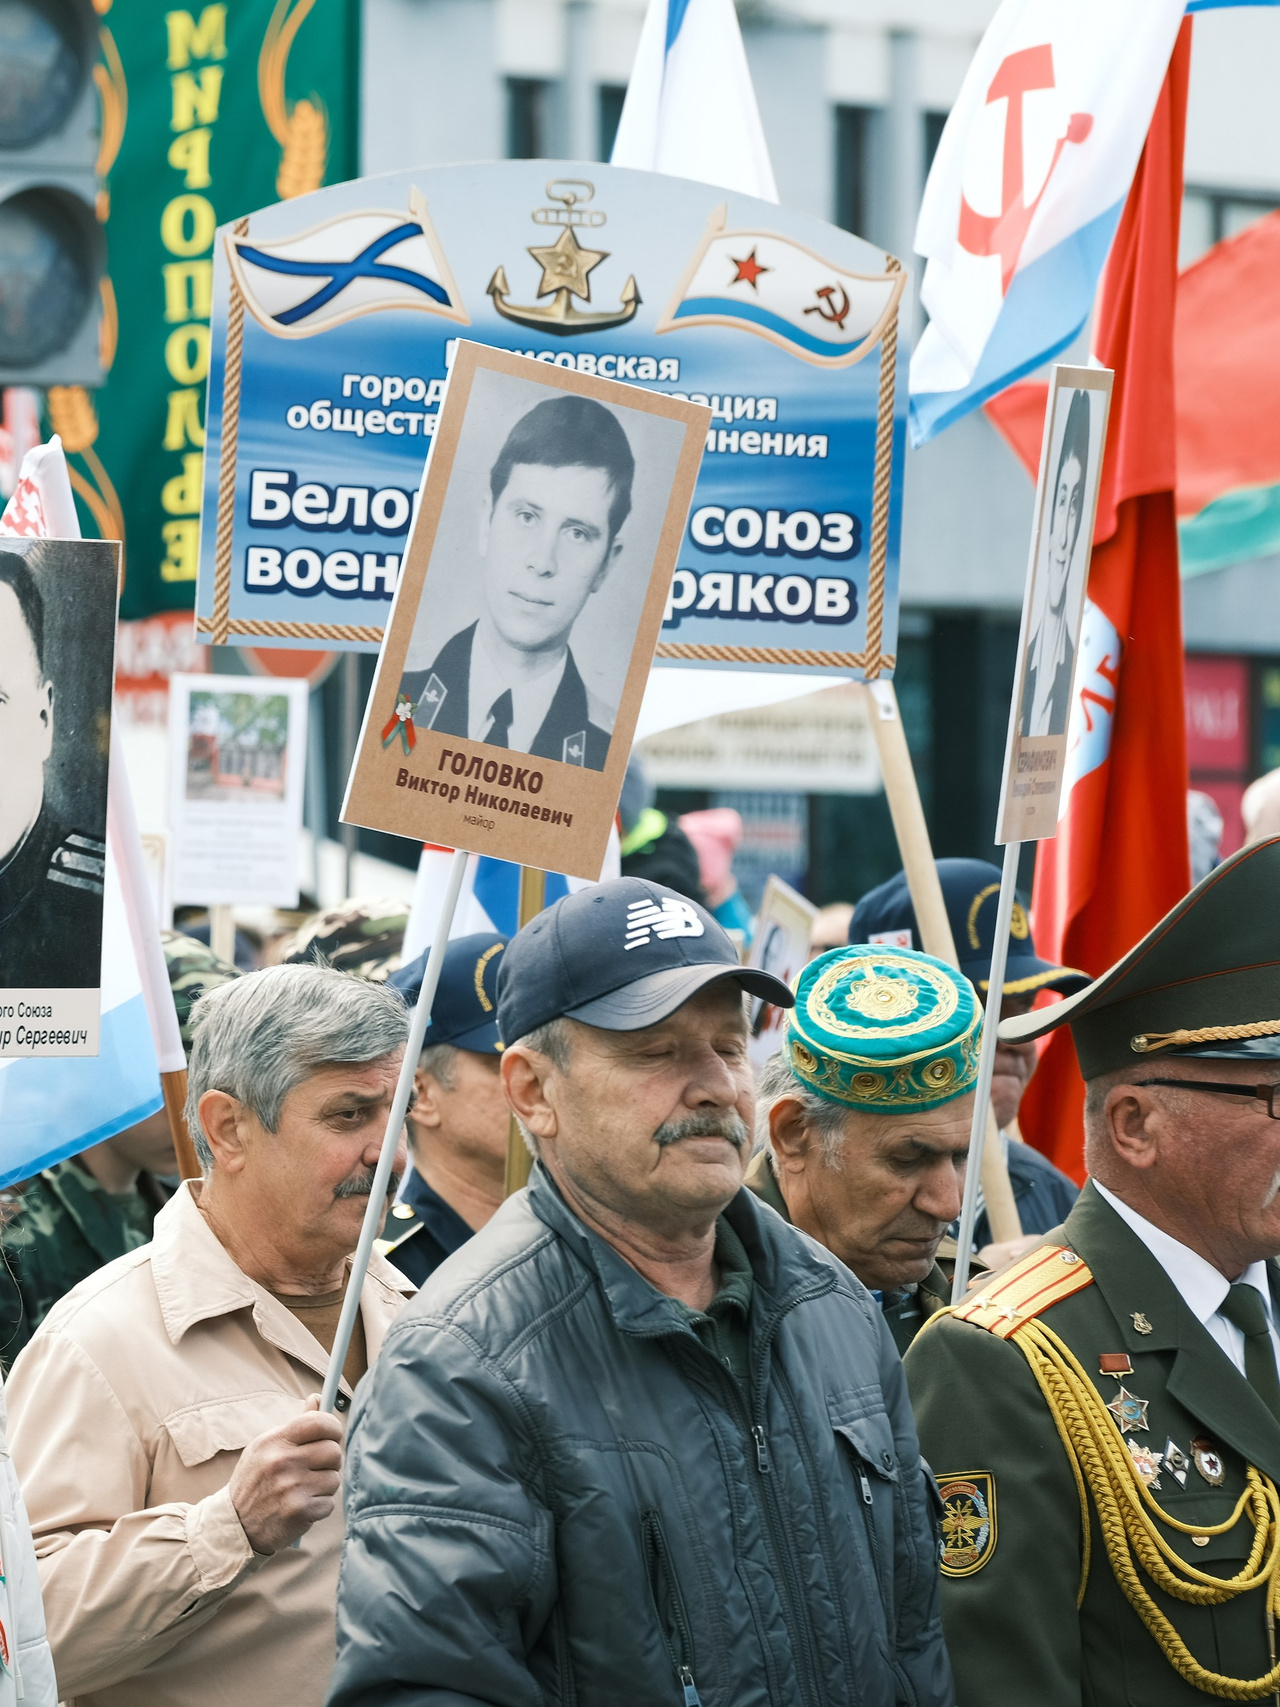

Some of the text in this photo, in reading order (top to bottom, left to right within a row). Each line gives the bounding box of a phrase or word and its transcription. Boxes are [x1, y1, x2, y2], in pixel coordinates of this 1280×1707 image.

[342, 374, 447, 407] город
[286, 400, 829, 459] обществ инения
[250, 470, 854, 553] Бело союз
[246, 547, 851, 621] воен ряков
[438, 748, 544, 795] ГОЛОВКО
[395, 767, 574, 828] Виктор Николаевич
[463, 813, 496, 832] майор
[18, 1002, 53, 1019] Союза
[16, 1025, 88, 1050] Сергеевич
